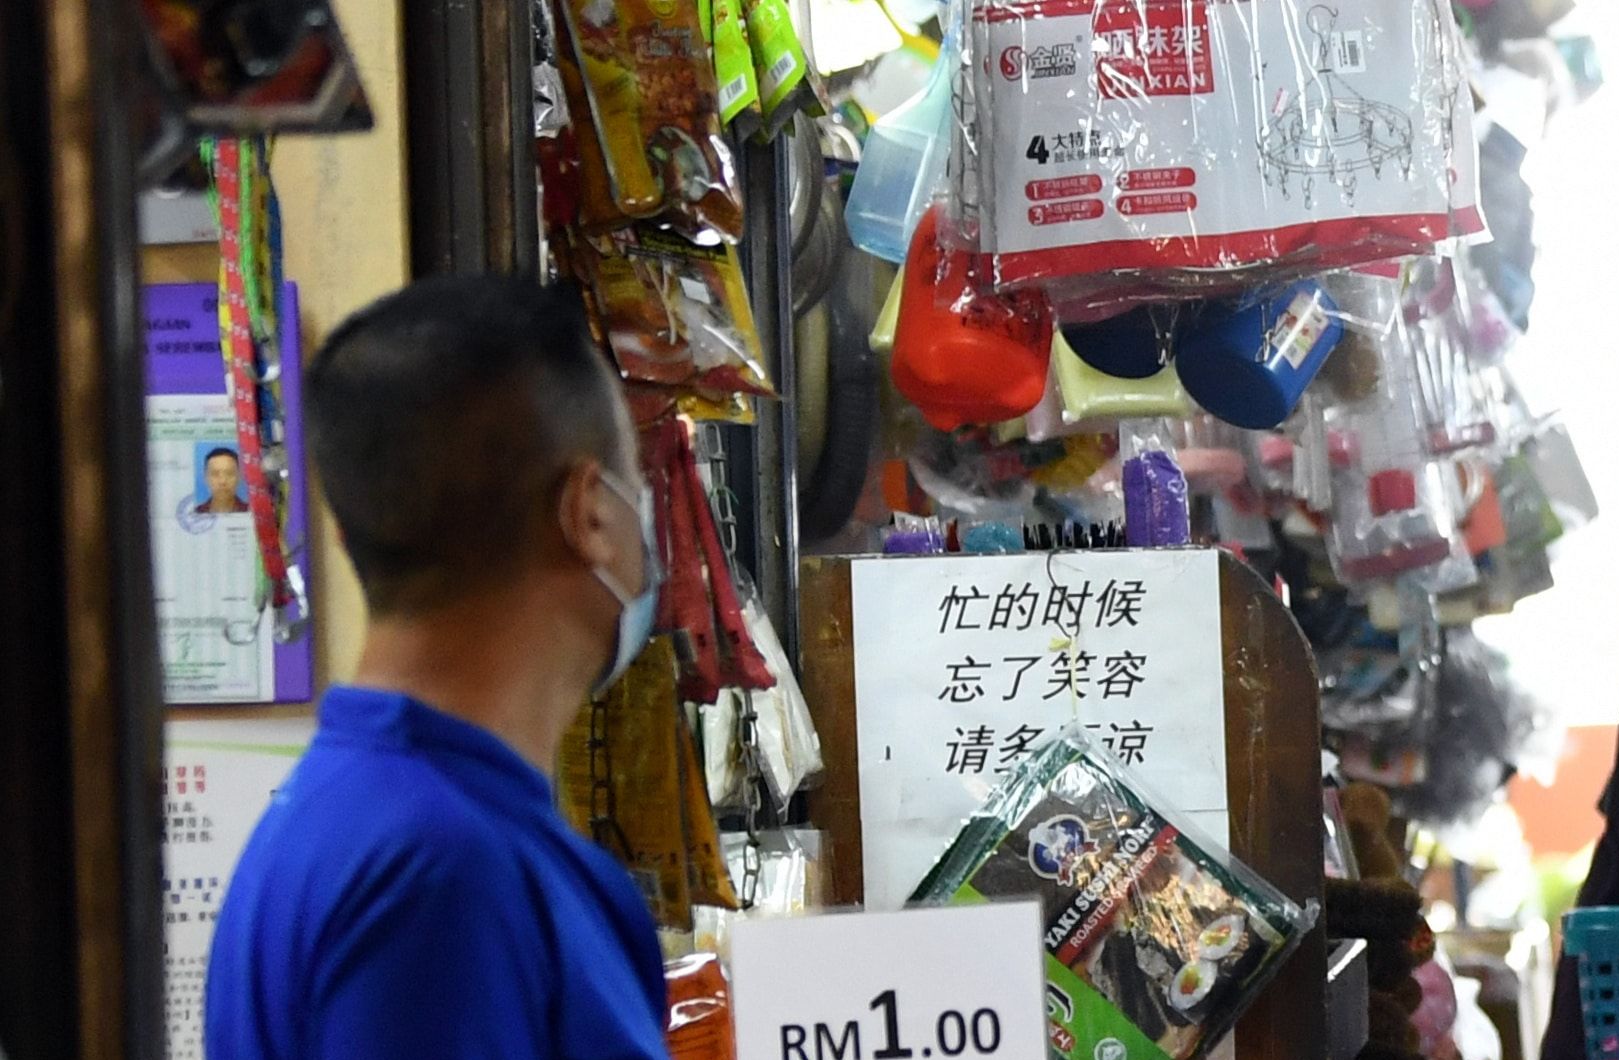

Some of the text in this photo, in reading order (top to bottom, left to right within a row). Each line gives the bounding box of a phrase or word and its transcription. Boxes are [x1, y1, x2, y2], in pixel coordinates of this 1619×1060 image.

[938, 579, 1147, 634] 忙的时候
[938, 650, 1147, 703] 忘了笑容
[945, 720, 1154, 775] 请多谅
[1044, 906, 1082, 949] YAKI
[1075, 860, 1122, 912] SUSHI
[1069, 897, 1114, 948] ROASTED
